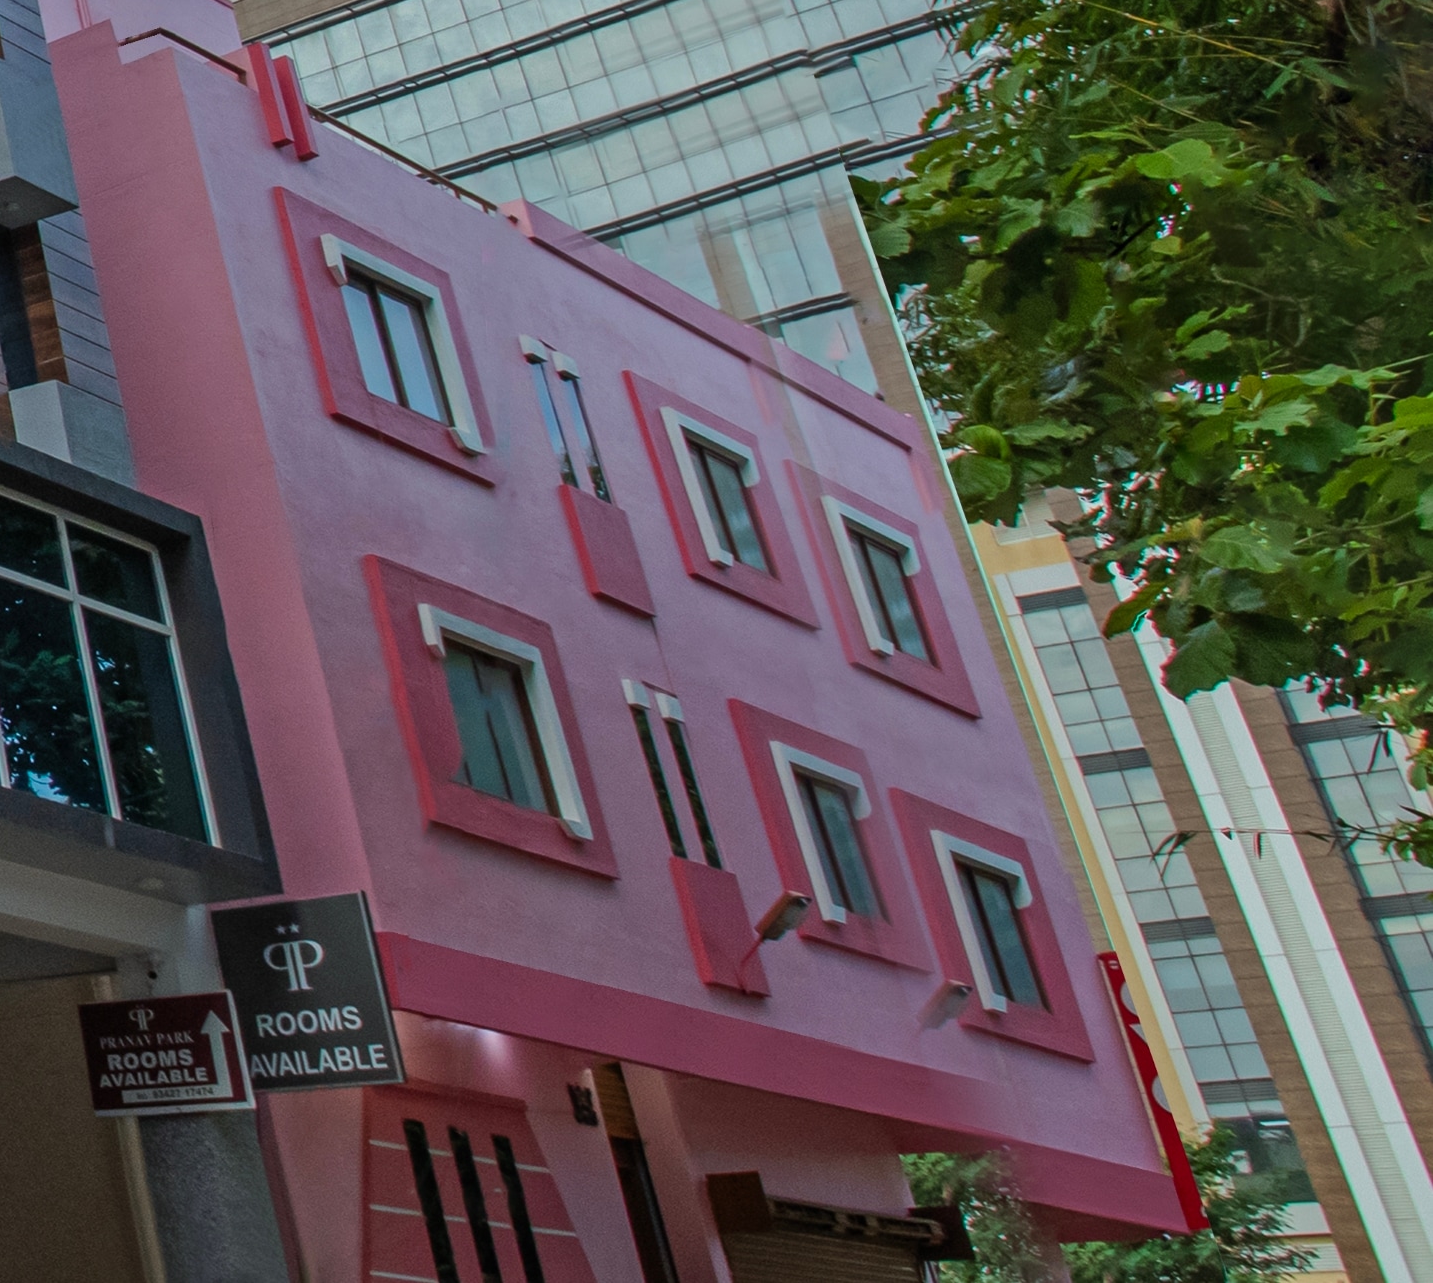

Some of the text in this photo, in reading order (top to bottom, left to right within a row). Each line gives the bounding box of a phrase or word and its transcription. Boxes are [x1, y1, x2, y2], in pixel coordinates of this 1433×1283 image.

[255, 1005, 363, 1038] ROOMS
[156, 1030, 195, 1045] PARK
[107, 1049, 193, 1071] ROOMS
[250, 1043, 388, 1079] AVAILABLE
[100, 1067, 209, 1088] AVAILABLE
